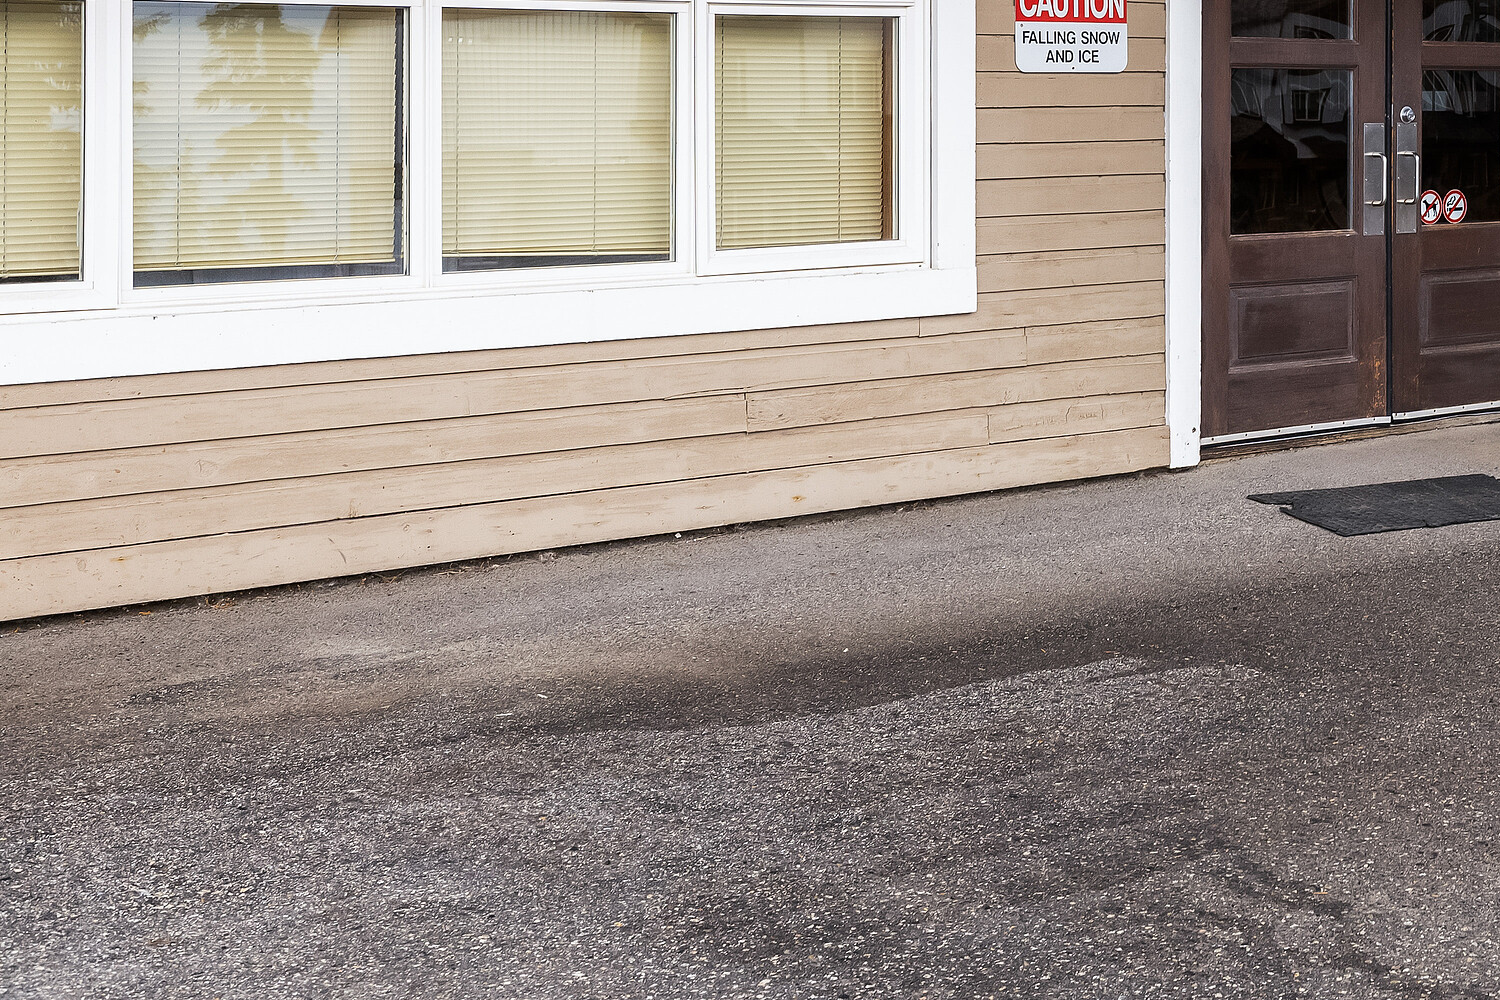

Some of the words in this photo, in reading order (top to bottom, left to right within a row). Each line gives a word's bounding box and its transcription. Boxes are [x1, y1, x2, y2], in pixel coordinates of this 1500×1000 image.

[1022, 30, 1076, 44] FALLING
[1081, 31, 1120, 45] SNOW
[1045, 49, 1074, 63] AND
[1079, 50, 1100, 63] ICE
